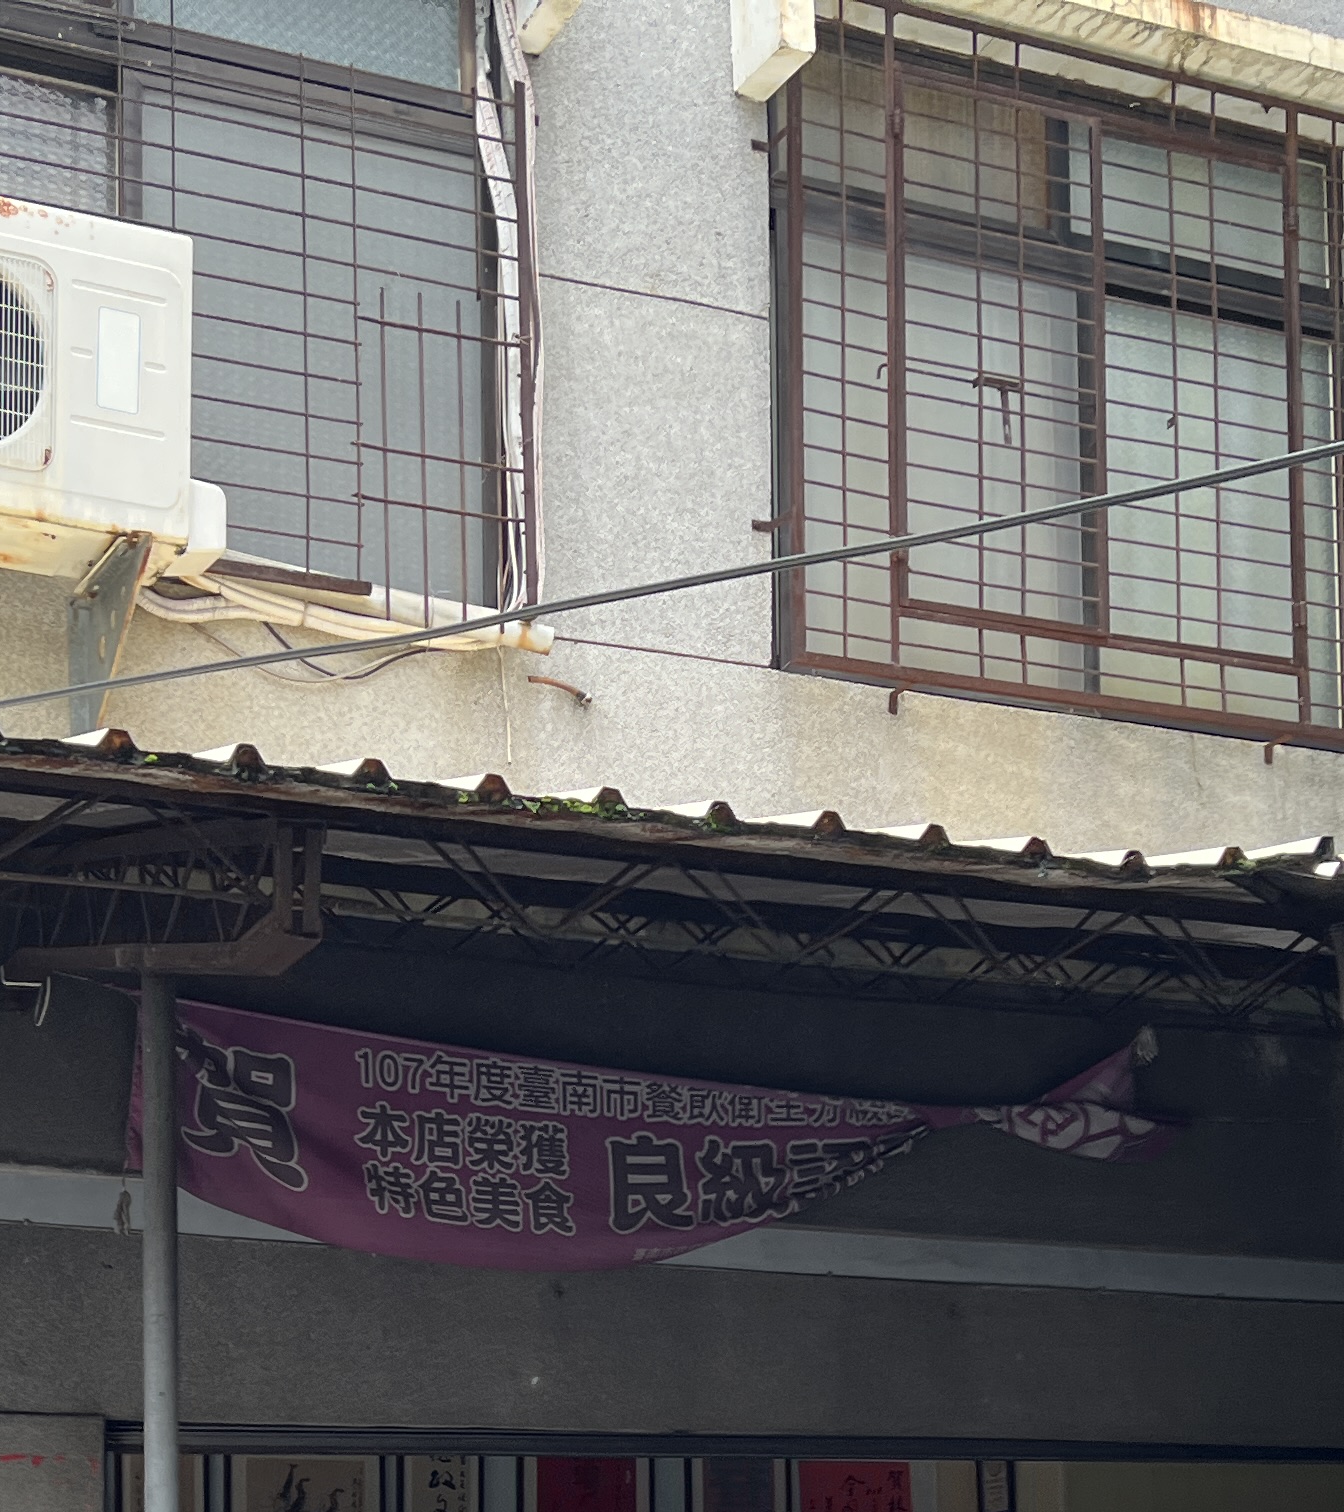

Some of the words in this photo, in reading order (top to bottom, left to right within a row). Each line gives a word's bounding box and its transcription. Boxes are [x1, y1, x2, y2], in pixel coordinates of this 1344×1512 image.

[176, 1023, 309, 1192] 賀
[354, 1101, 570, 1180] 本店榮獲
[362, 1162, 577, 1236] 特色美食
